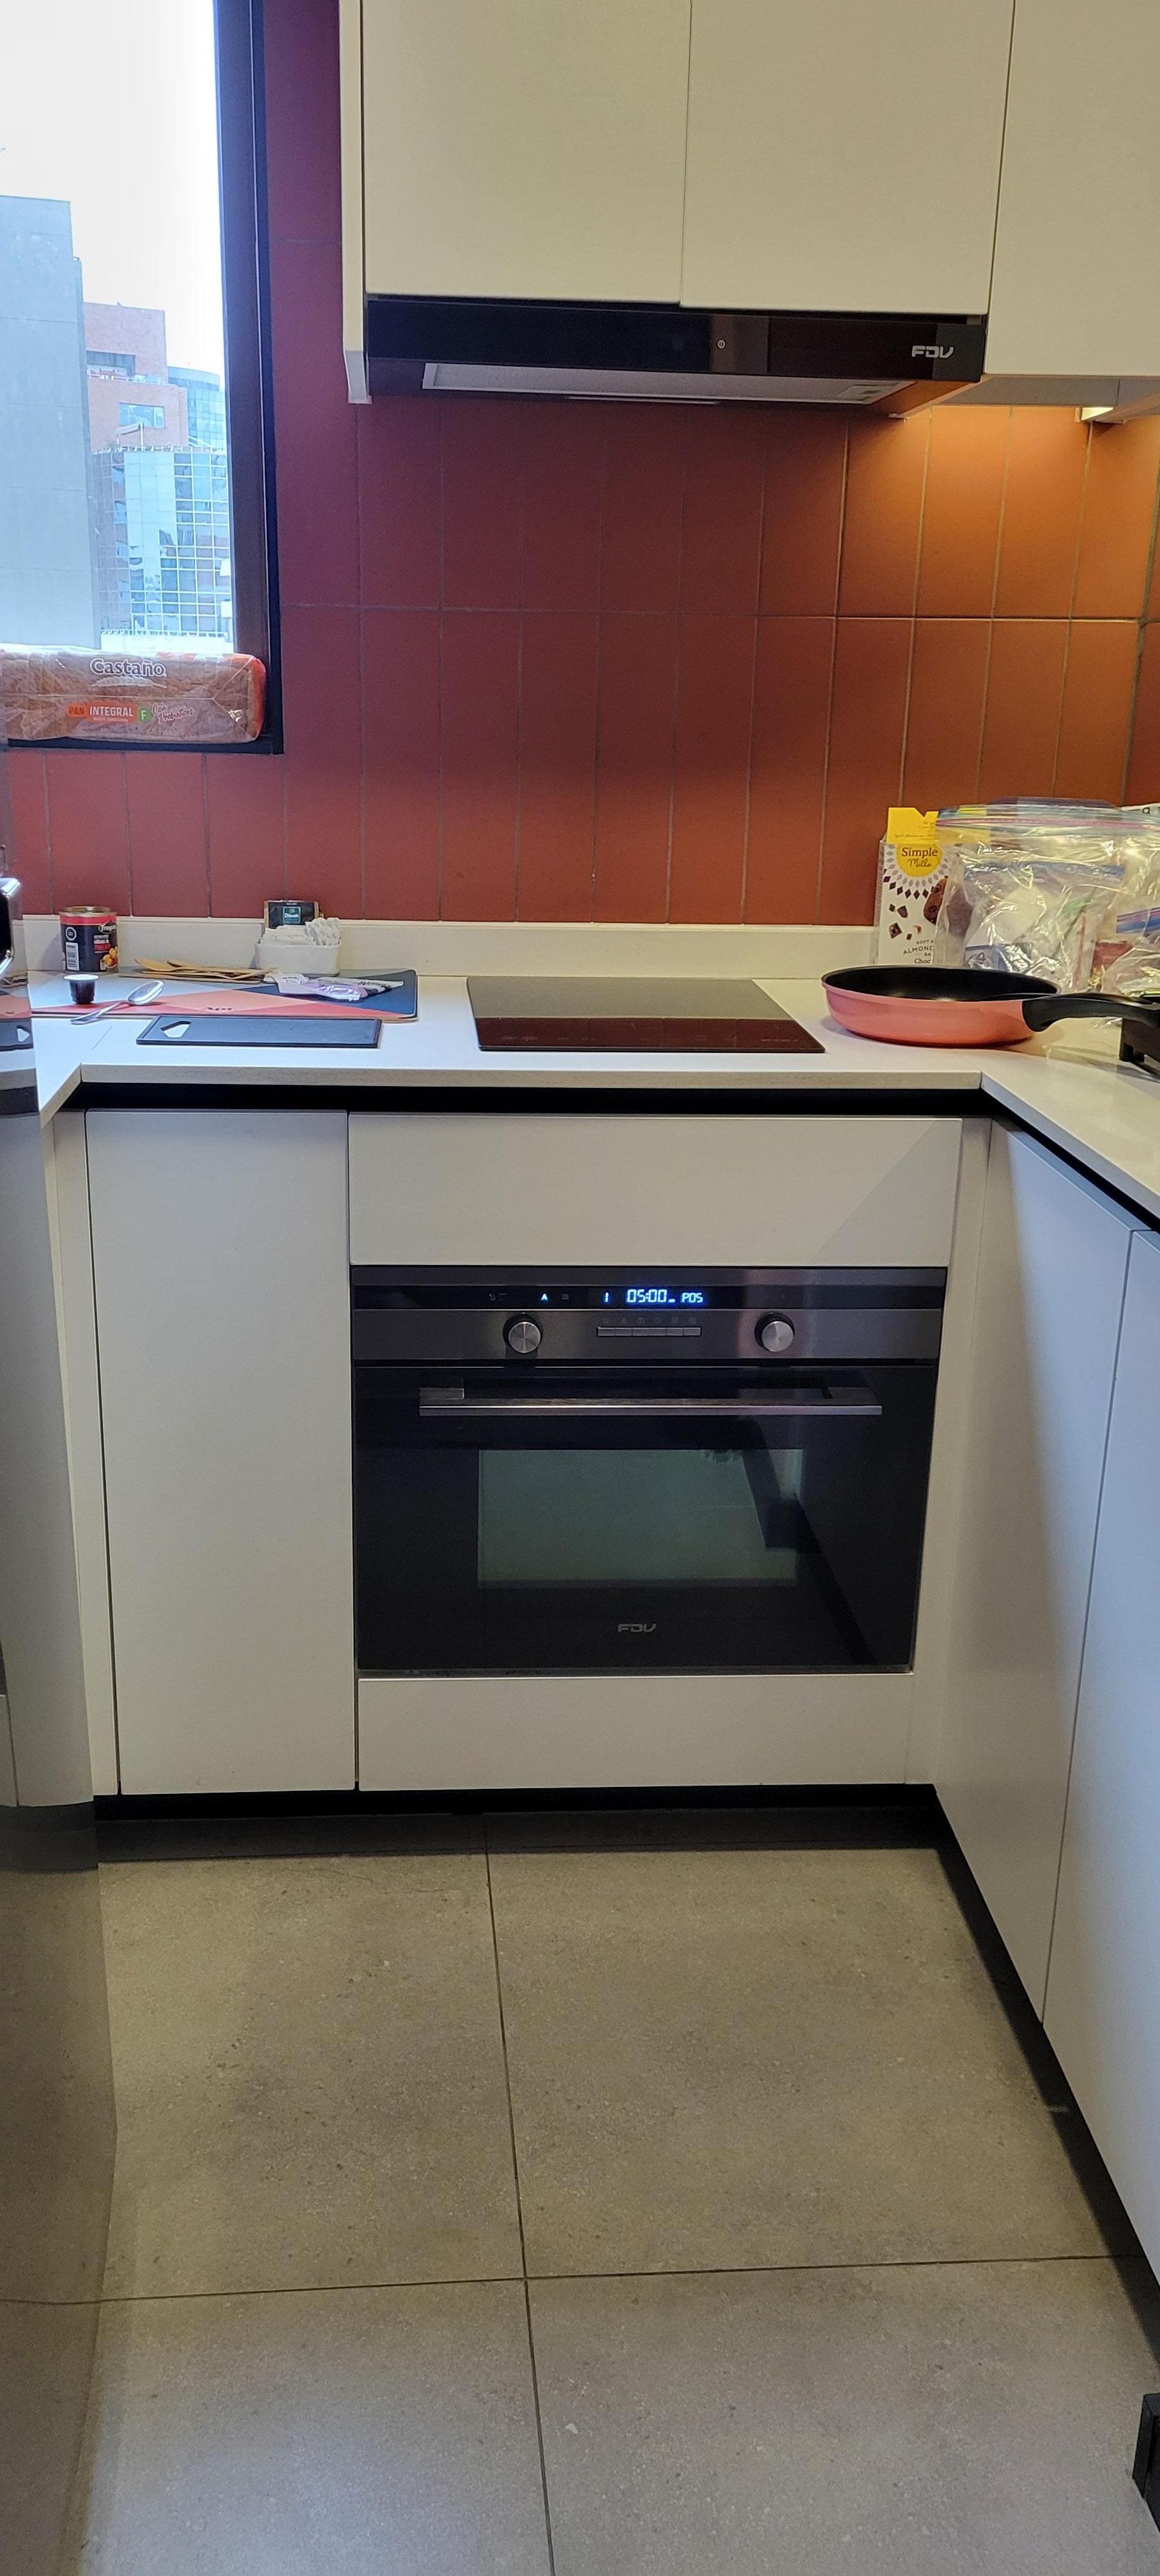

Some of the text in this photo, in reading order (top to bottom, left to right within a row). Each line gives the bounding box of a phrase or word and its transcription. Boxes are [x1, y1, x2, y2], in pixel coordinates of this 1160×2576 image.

[912, 346, 954, 358] FDV
[90, 658, 167, 677] Castaño
[69, 706, 134, 717] PAN INTEGRAL
[141, 710, 147, 720] F
[901, 847, 938, 858] Simple
[908, 858, 931, 868] Mills
[627, 1289, 668, 1303] 05:00
[682, 1292, 703, 1303] POS
[617, 1623, 657, 1632] FDV
